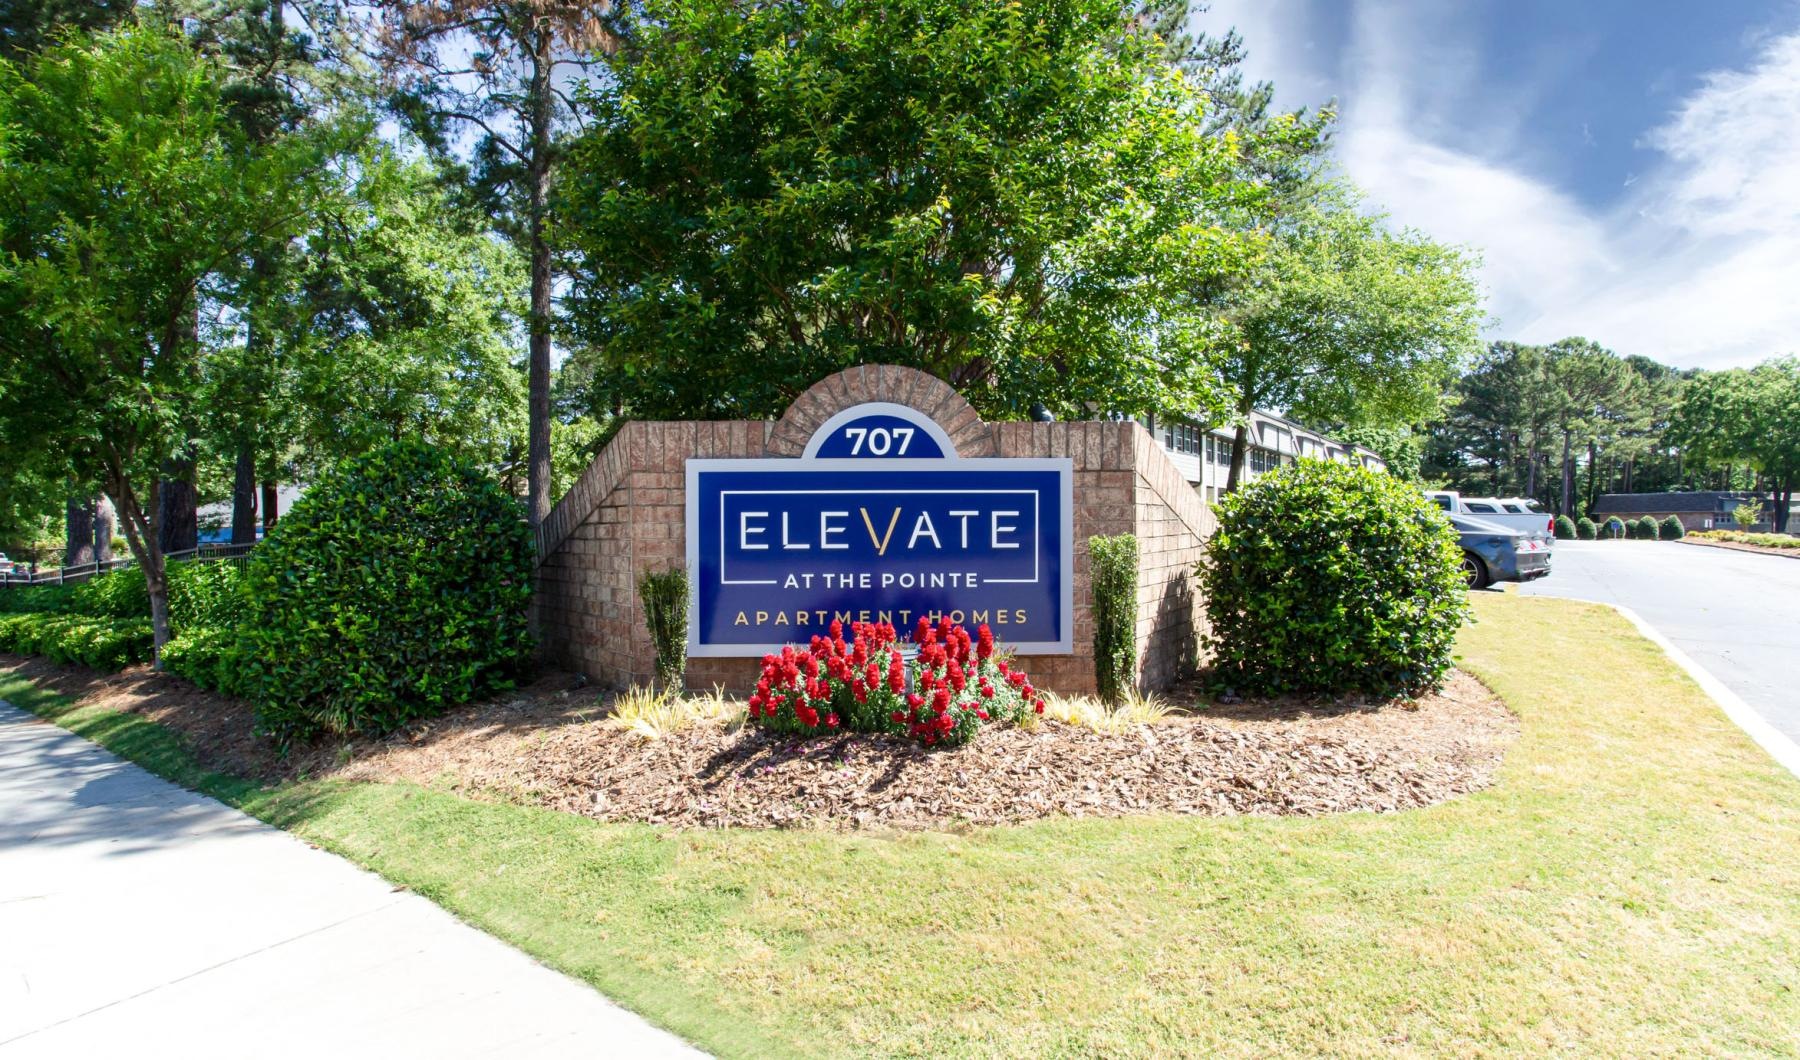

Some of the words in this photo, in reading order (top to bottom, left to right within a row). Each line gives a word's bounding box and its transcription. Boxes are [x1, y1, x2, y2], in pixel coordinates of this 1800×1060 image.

[845, 427, 914, 456] 707
[739, 507, 1020, 556] ELEVATE
[783, 574, 815, 589] AT
[822, 574, 871, 589] THE
[881, 573, 978, 588] POINTE
[734, 610, 911, 626] APARTMENT
[928, 609, 1028, 625] HOMES
